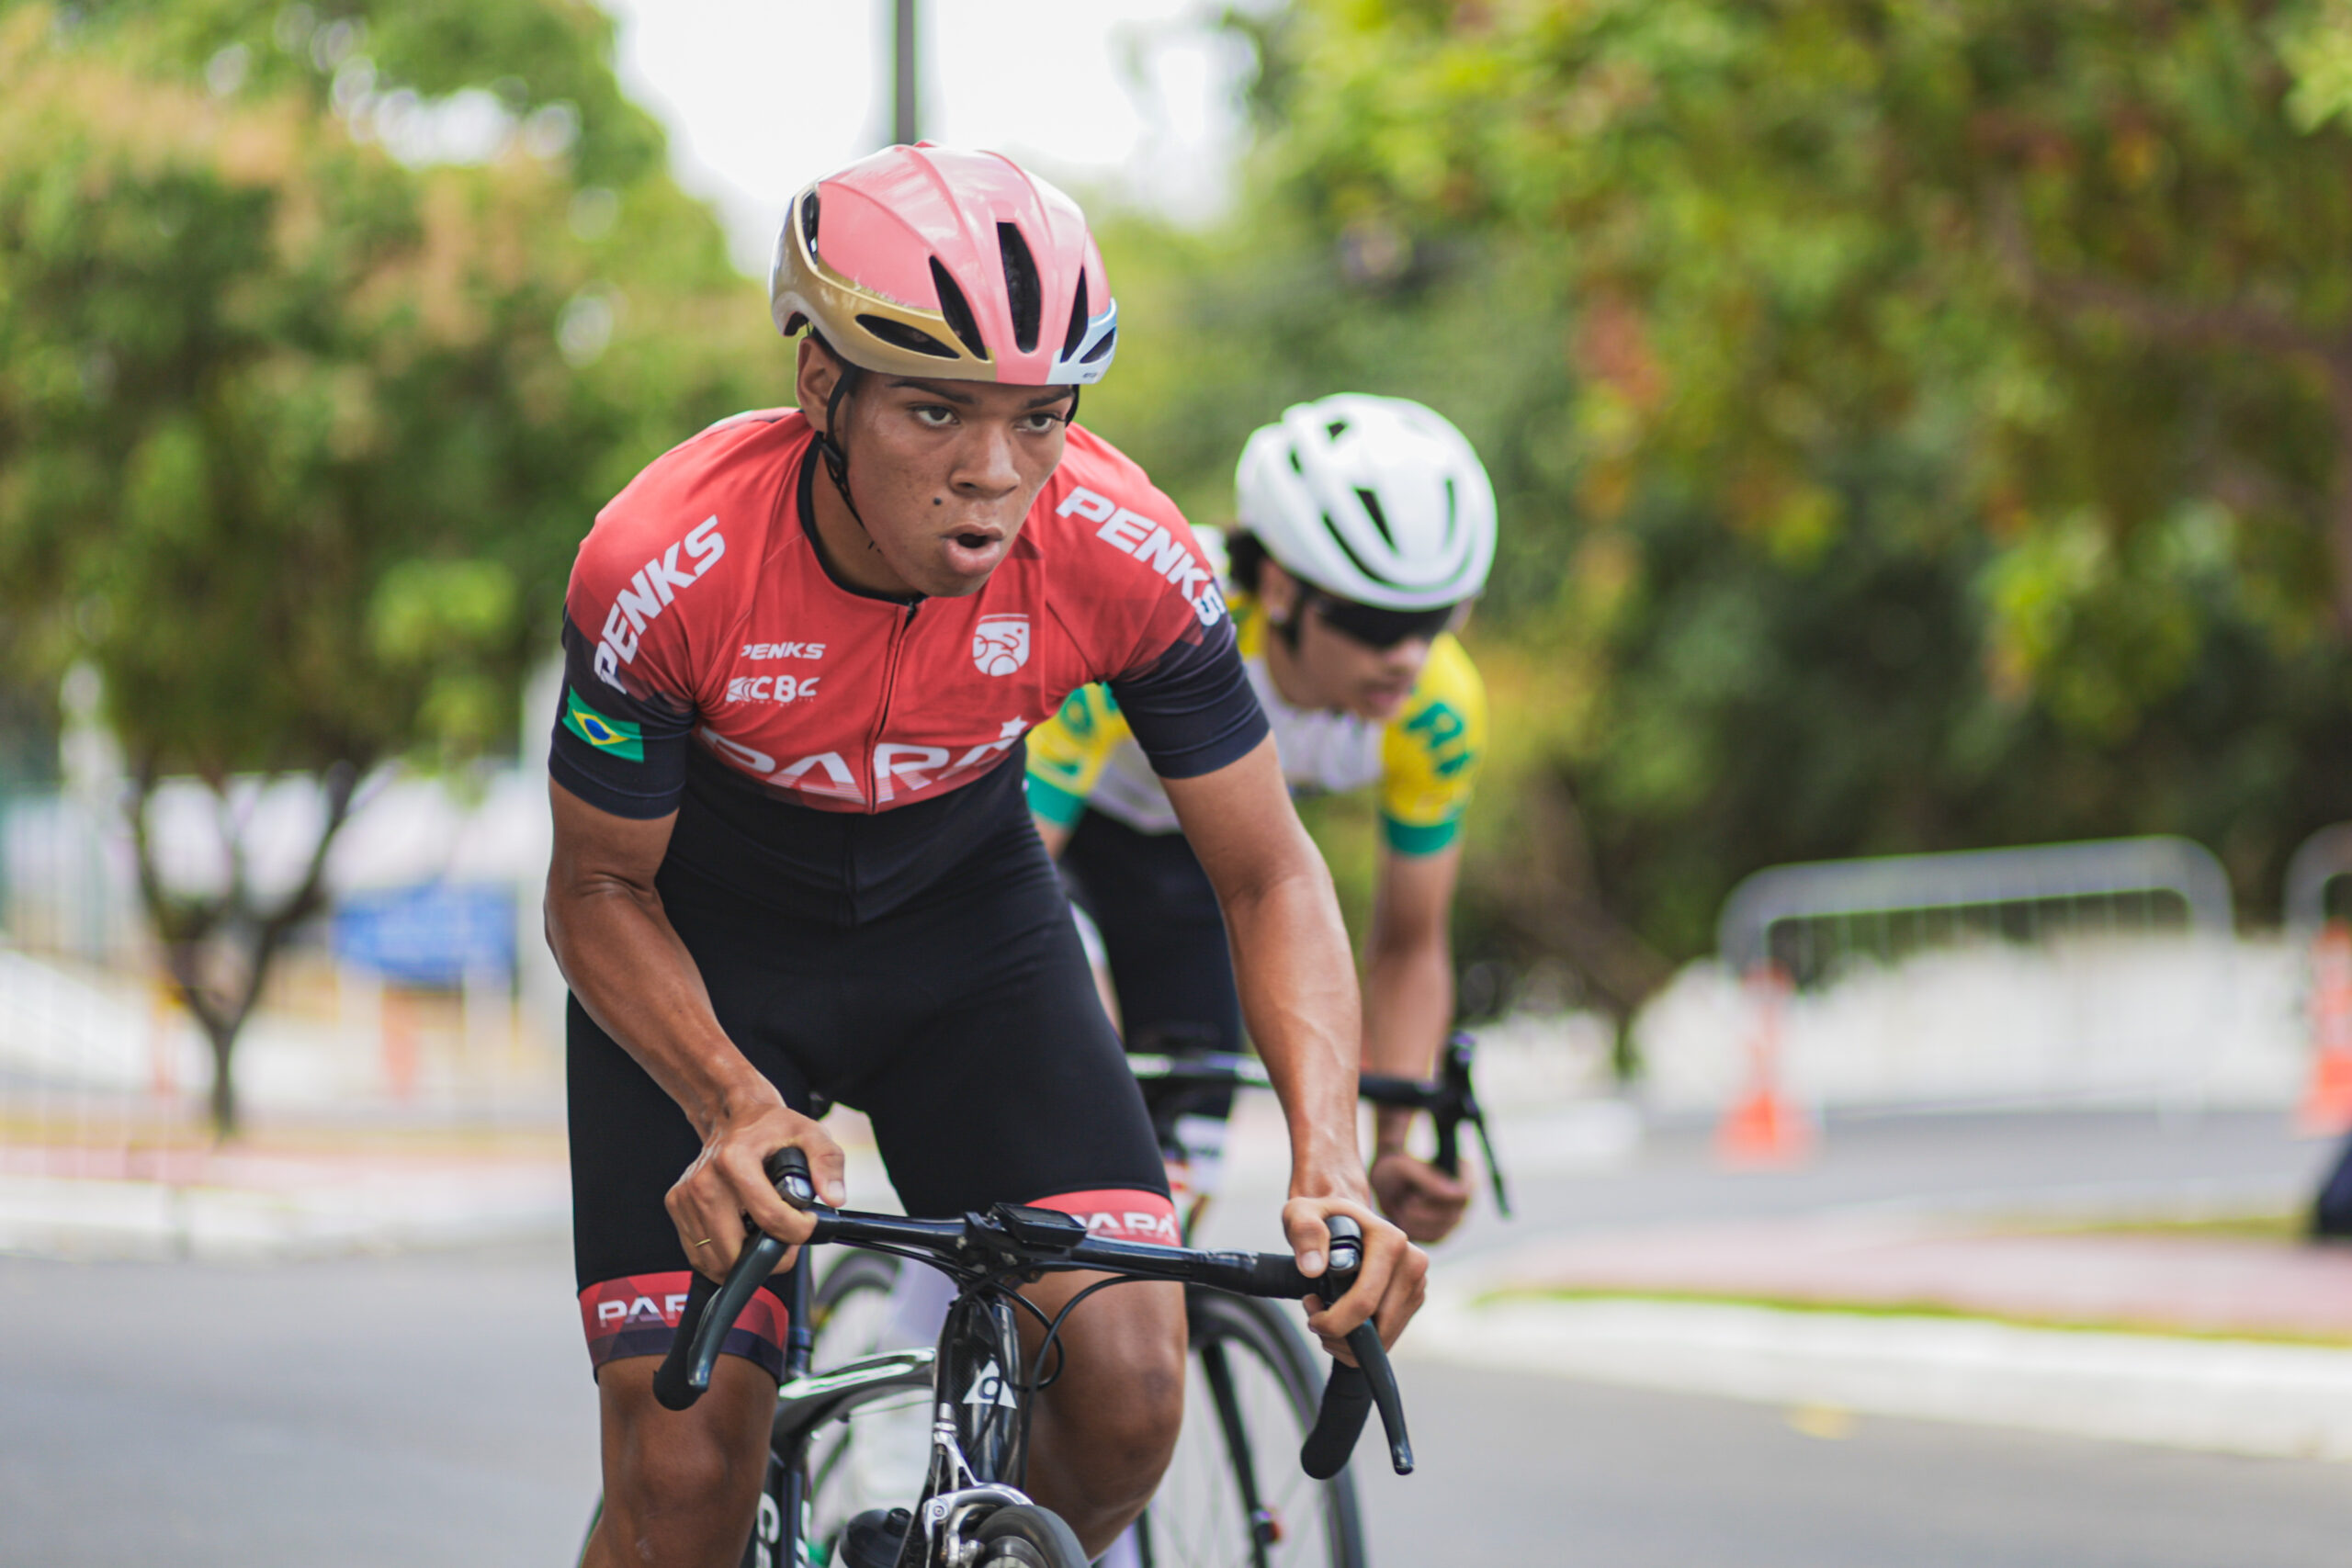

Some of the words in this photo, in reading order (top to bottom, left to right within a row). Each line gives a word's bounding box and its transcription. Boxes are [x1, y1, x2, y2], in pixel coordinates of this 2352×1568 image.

[1055, 485, 1226, 626] PENKS
[594, 514, 725, 694] PENKS
[741, 641, 826, 660] PENKS
[750, 674, 820, 703] CBC
